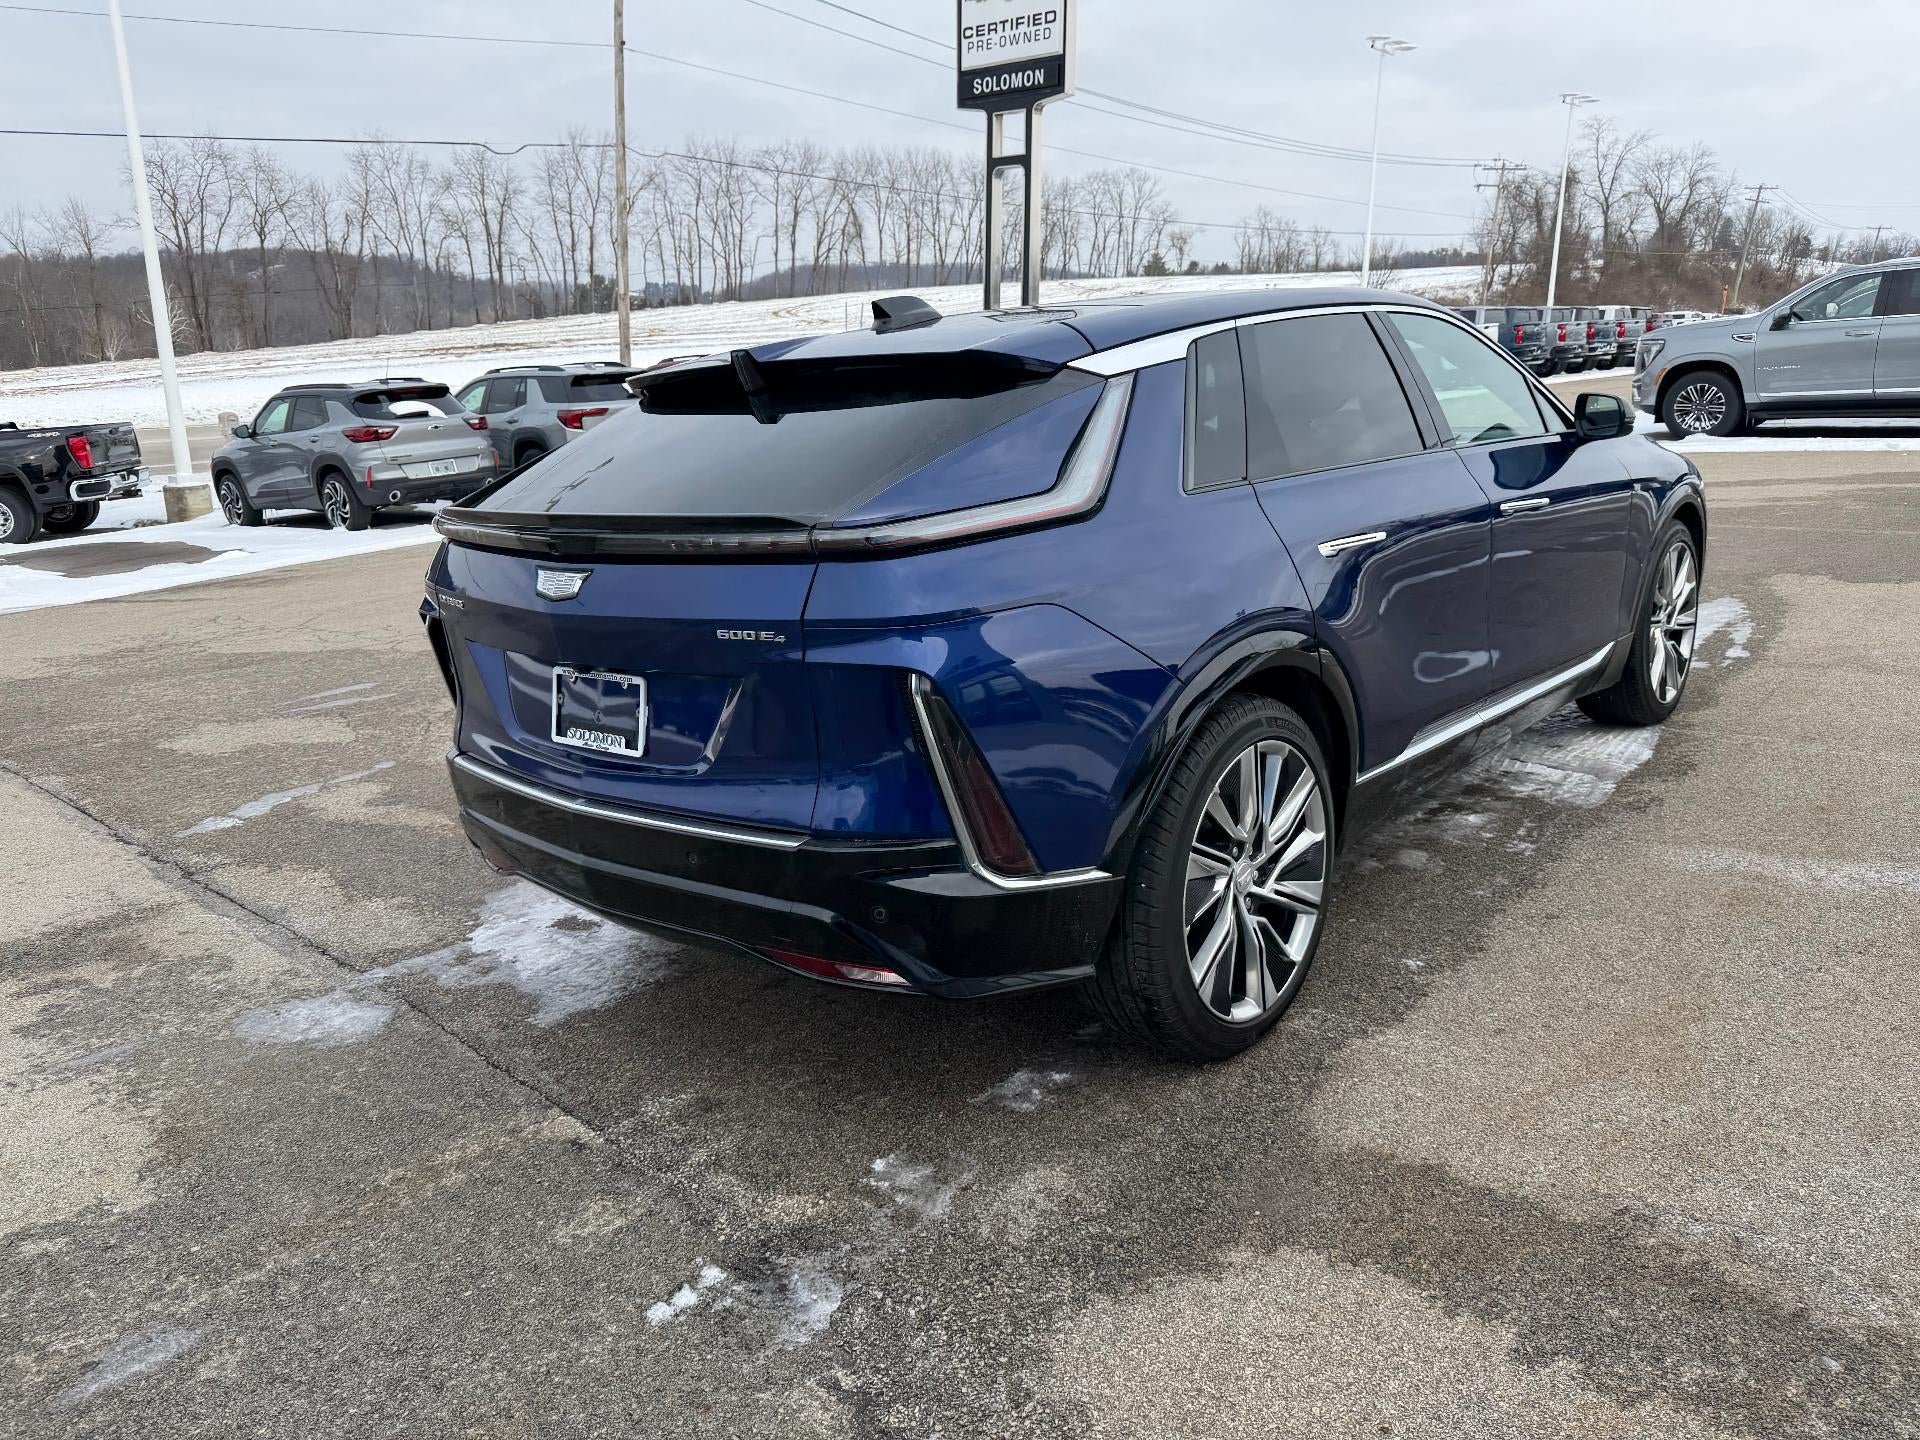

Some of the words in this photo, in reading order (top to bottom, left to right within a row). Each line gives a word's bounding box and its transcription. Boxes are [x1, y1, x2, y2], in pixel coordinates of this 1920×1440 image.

[963, 10, 1057, 40] CERTIFIED
[967, 27, 1052, 54] PRE-OWNED
[973, 68, 1045, 95] SOLOMON
[716, 629, 756, 641] 600
[567, 729, 623, 748] SOLOMON
